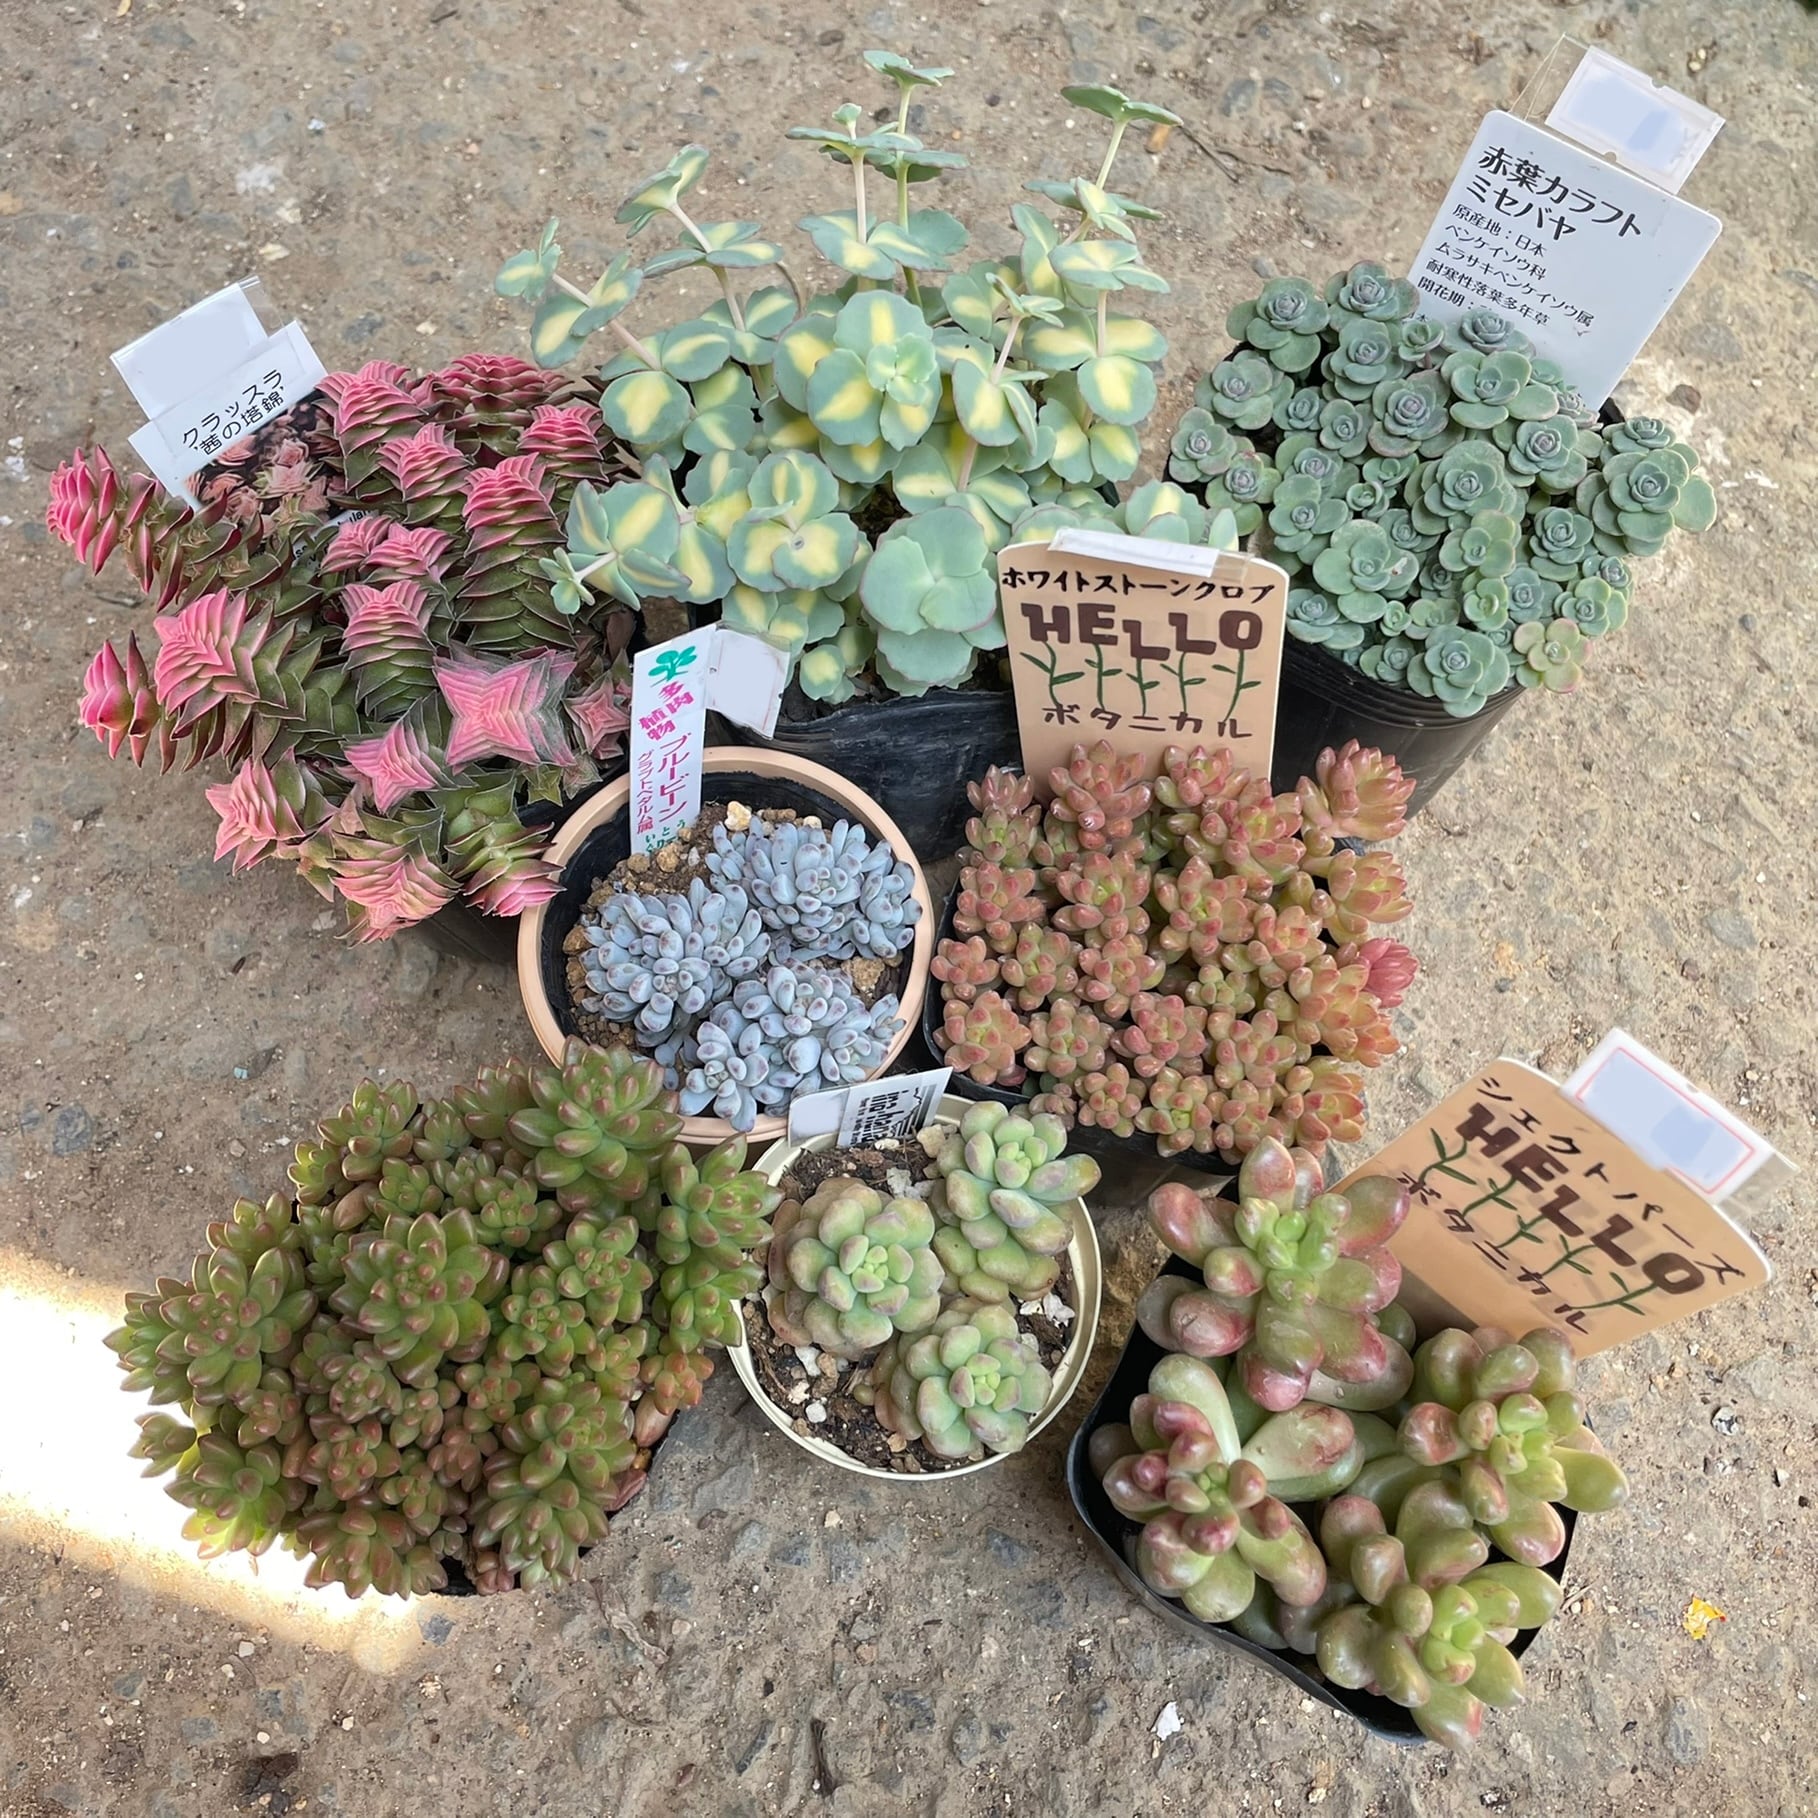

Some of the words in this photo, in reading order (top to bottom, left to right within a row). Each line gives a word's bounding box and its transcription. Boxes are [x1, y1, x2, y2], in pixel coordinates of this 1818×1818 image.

[1466, 174, 1577, 241] ミセバヤ
[1477, 145, 1642, 237] 赤葉カラフト
[1435, 243, 1596, 327] ムラサキベンケイソウ属
[1445, 225, 1547, 281] ベンケイソウ科
[1418, 276, 1494, 312] 開花期：
[1425, 258, 1551, 327] 耐寒性落葉多年草
[182, 369, 283, 449] クラッスラ
[1020, 602, 1263, 662] HELLO
[1042, 703, 1253, 739] ボタニカル
[657, 732, 692, 822] ブルービーン
[1455, 1102, 1706, 1296] HELLO
[1397, 1171, 1590, 1336] ボタニカル
